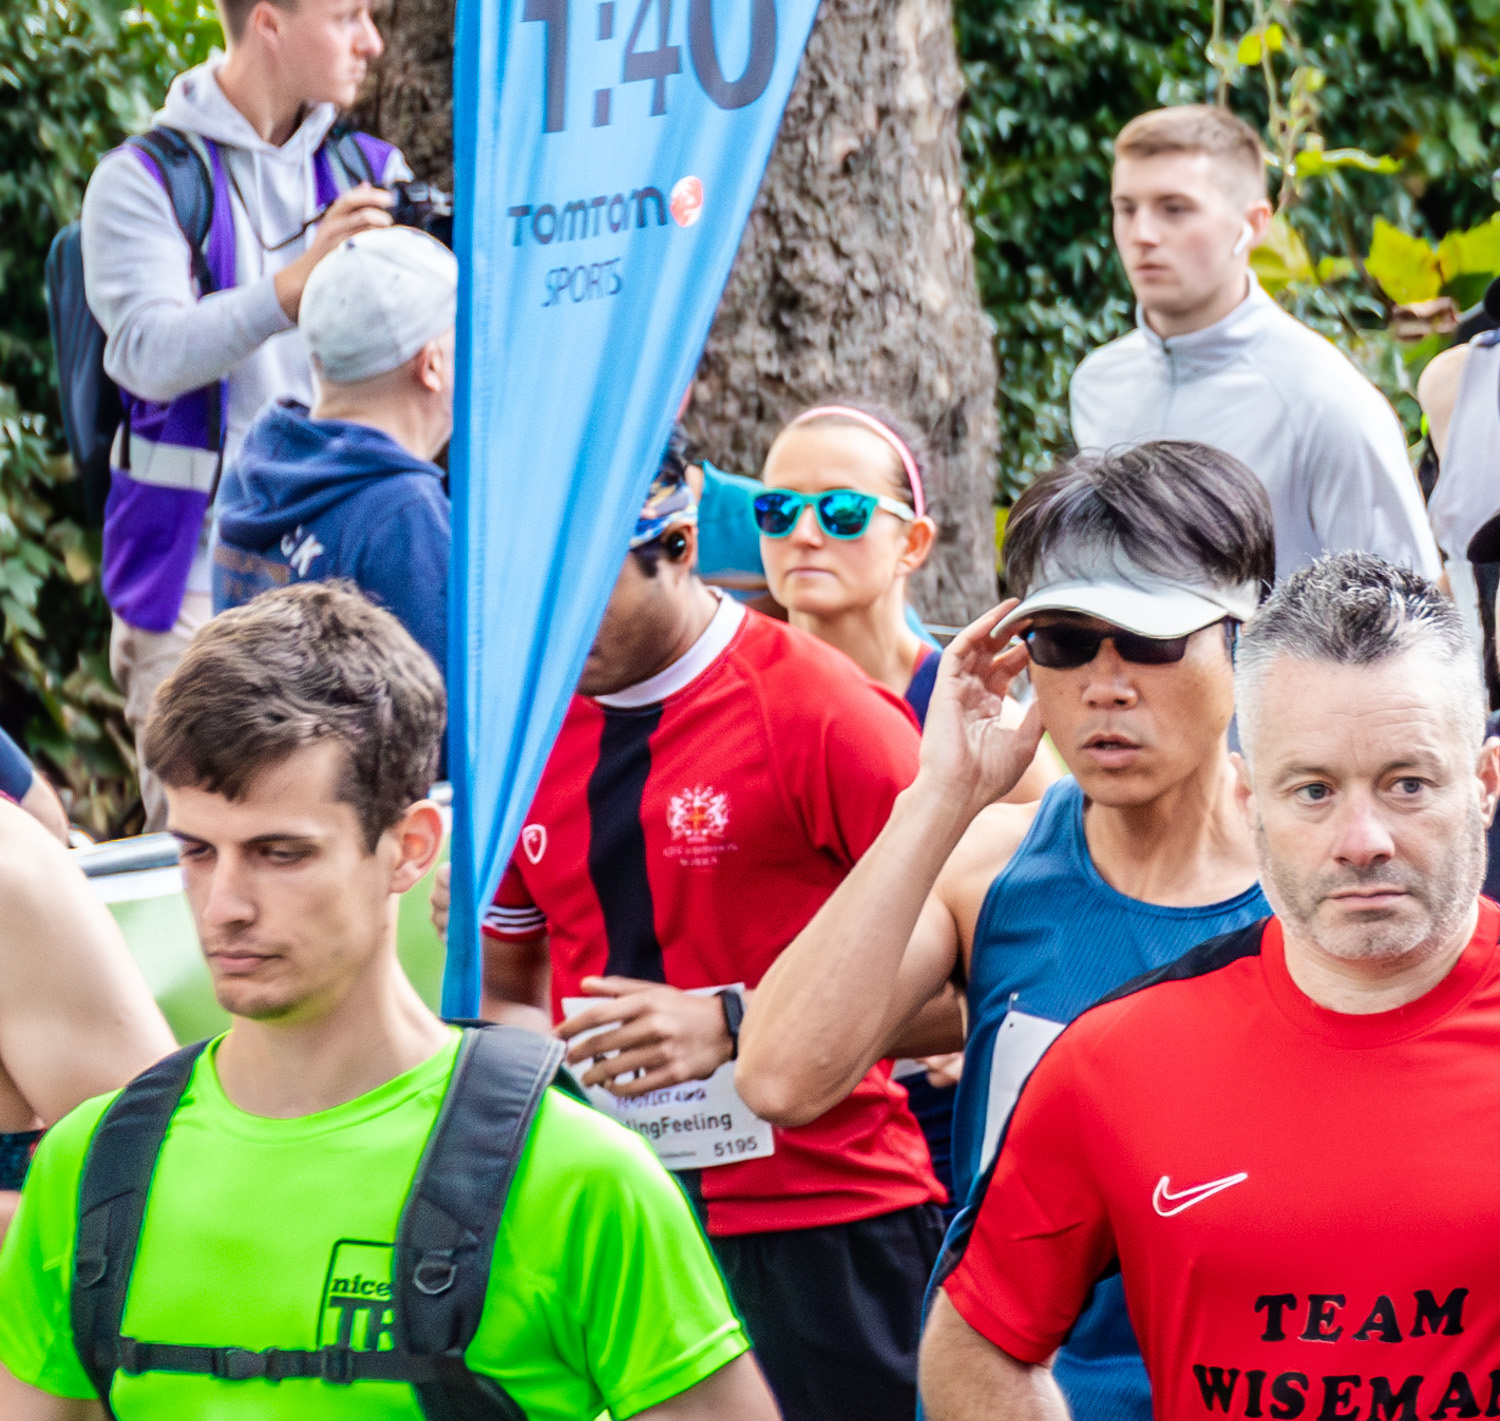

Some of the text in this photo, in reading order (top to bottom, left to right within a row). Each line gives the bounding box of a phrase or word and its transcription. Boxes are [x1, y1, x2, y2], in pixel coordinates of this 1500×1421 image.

[520, 0, 777, 133] 1:40
[331, 1273, 393, 1297] nice
[1254, 1287, 1469, 1343] TEAM
